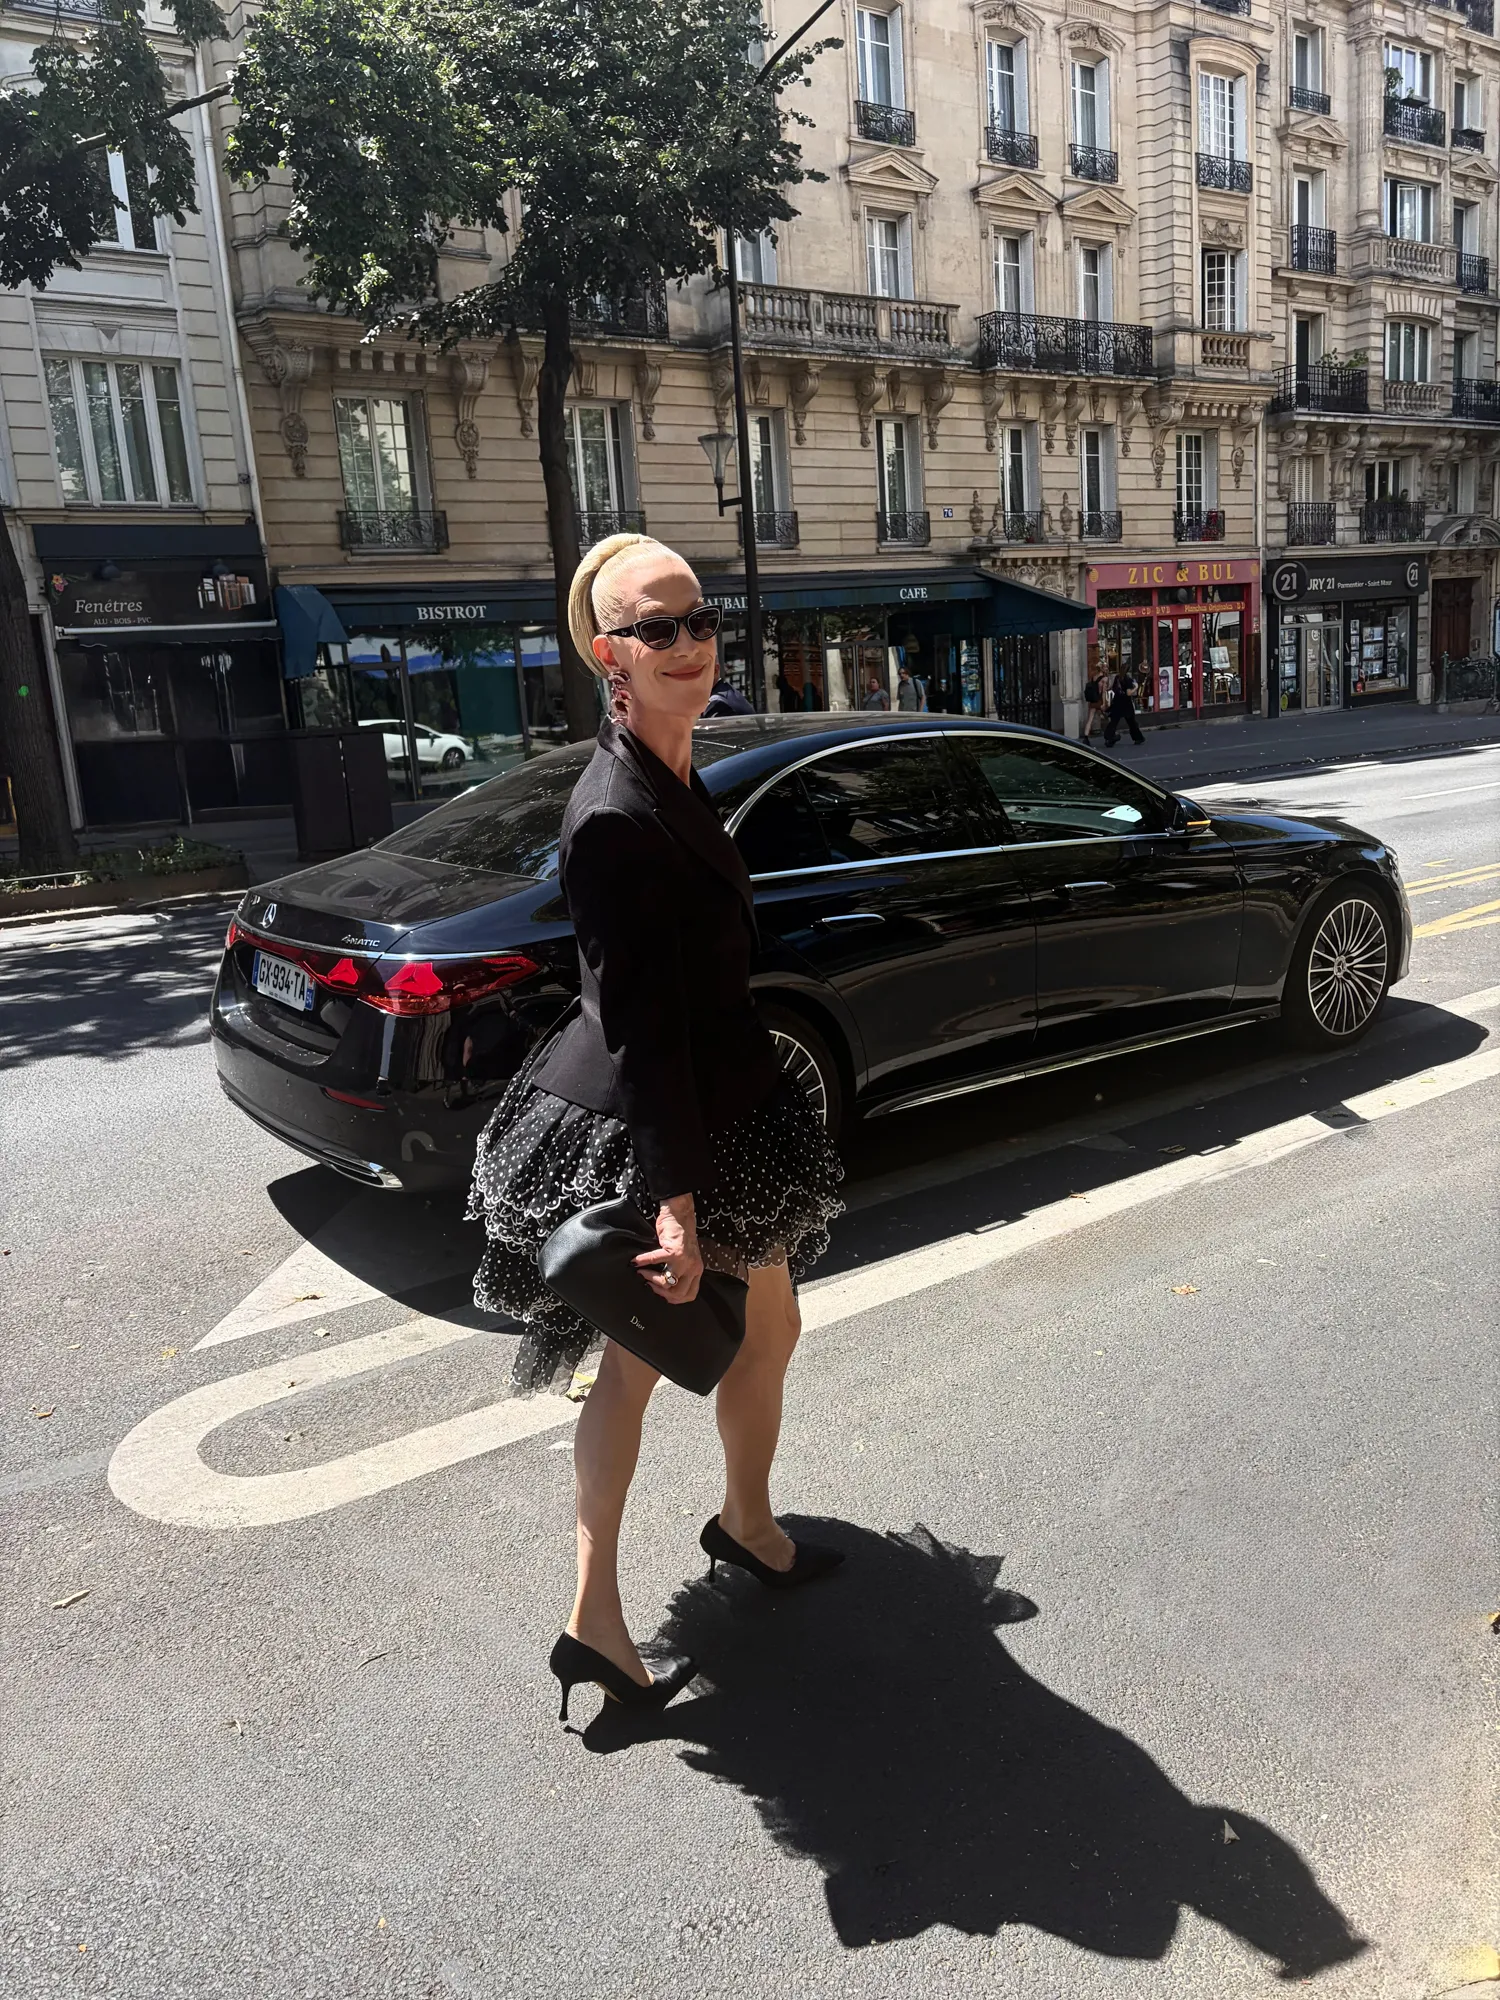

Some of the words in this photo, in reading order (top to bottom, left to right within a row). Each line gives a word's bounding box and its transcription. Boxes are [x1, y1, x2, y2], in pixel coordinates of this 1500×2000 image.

[944, 509, 953, 518] 76
[1128, 567, 1164, 584] ZIC
[1176, 566, 1189, 582] &
[1199, 564, 1235, 581] BUL
[1411, 569, 1418, 581] 21
[1281, 573, 1297, 591] 21
[1327, 577, 1335, 590] 21
[900, 587, 928, 600] CAFE
[417, 605, 487, 620] BISTROT
[137, 616, 152, 624] PVC
[259, 959, 305, 1001] GX-934-TA
[630, 1315, 645, 1331] Dior
